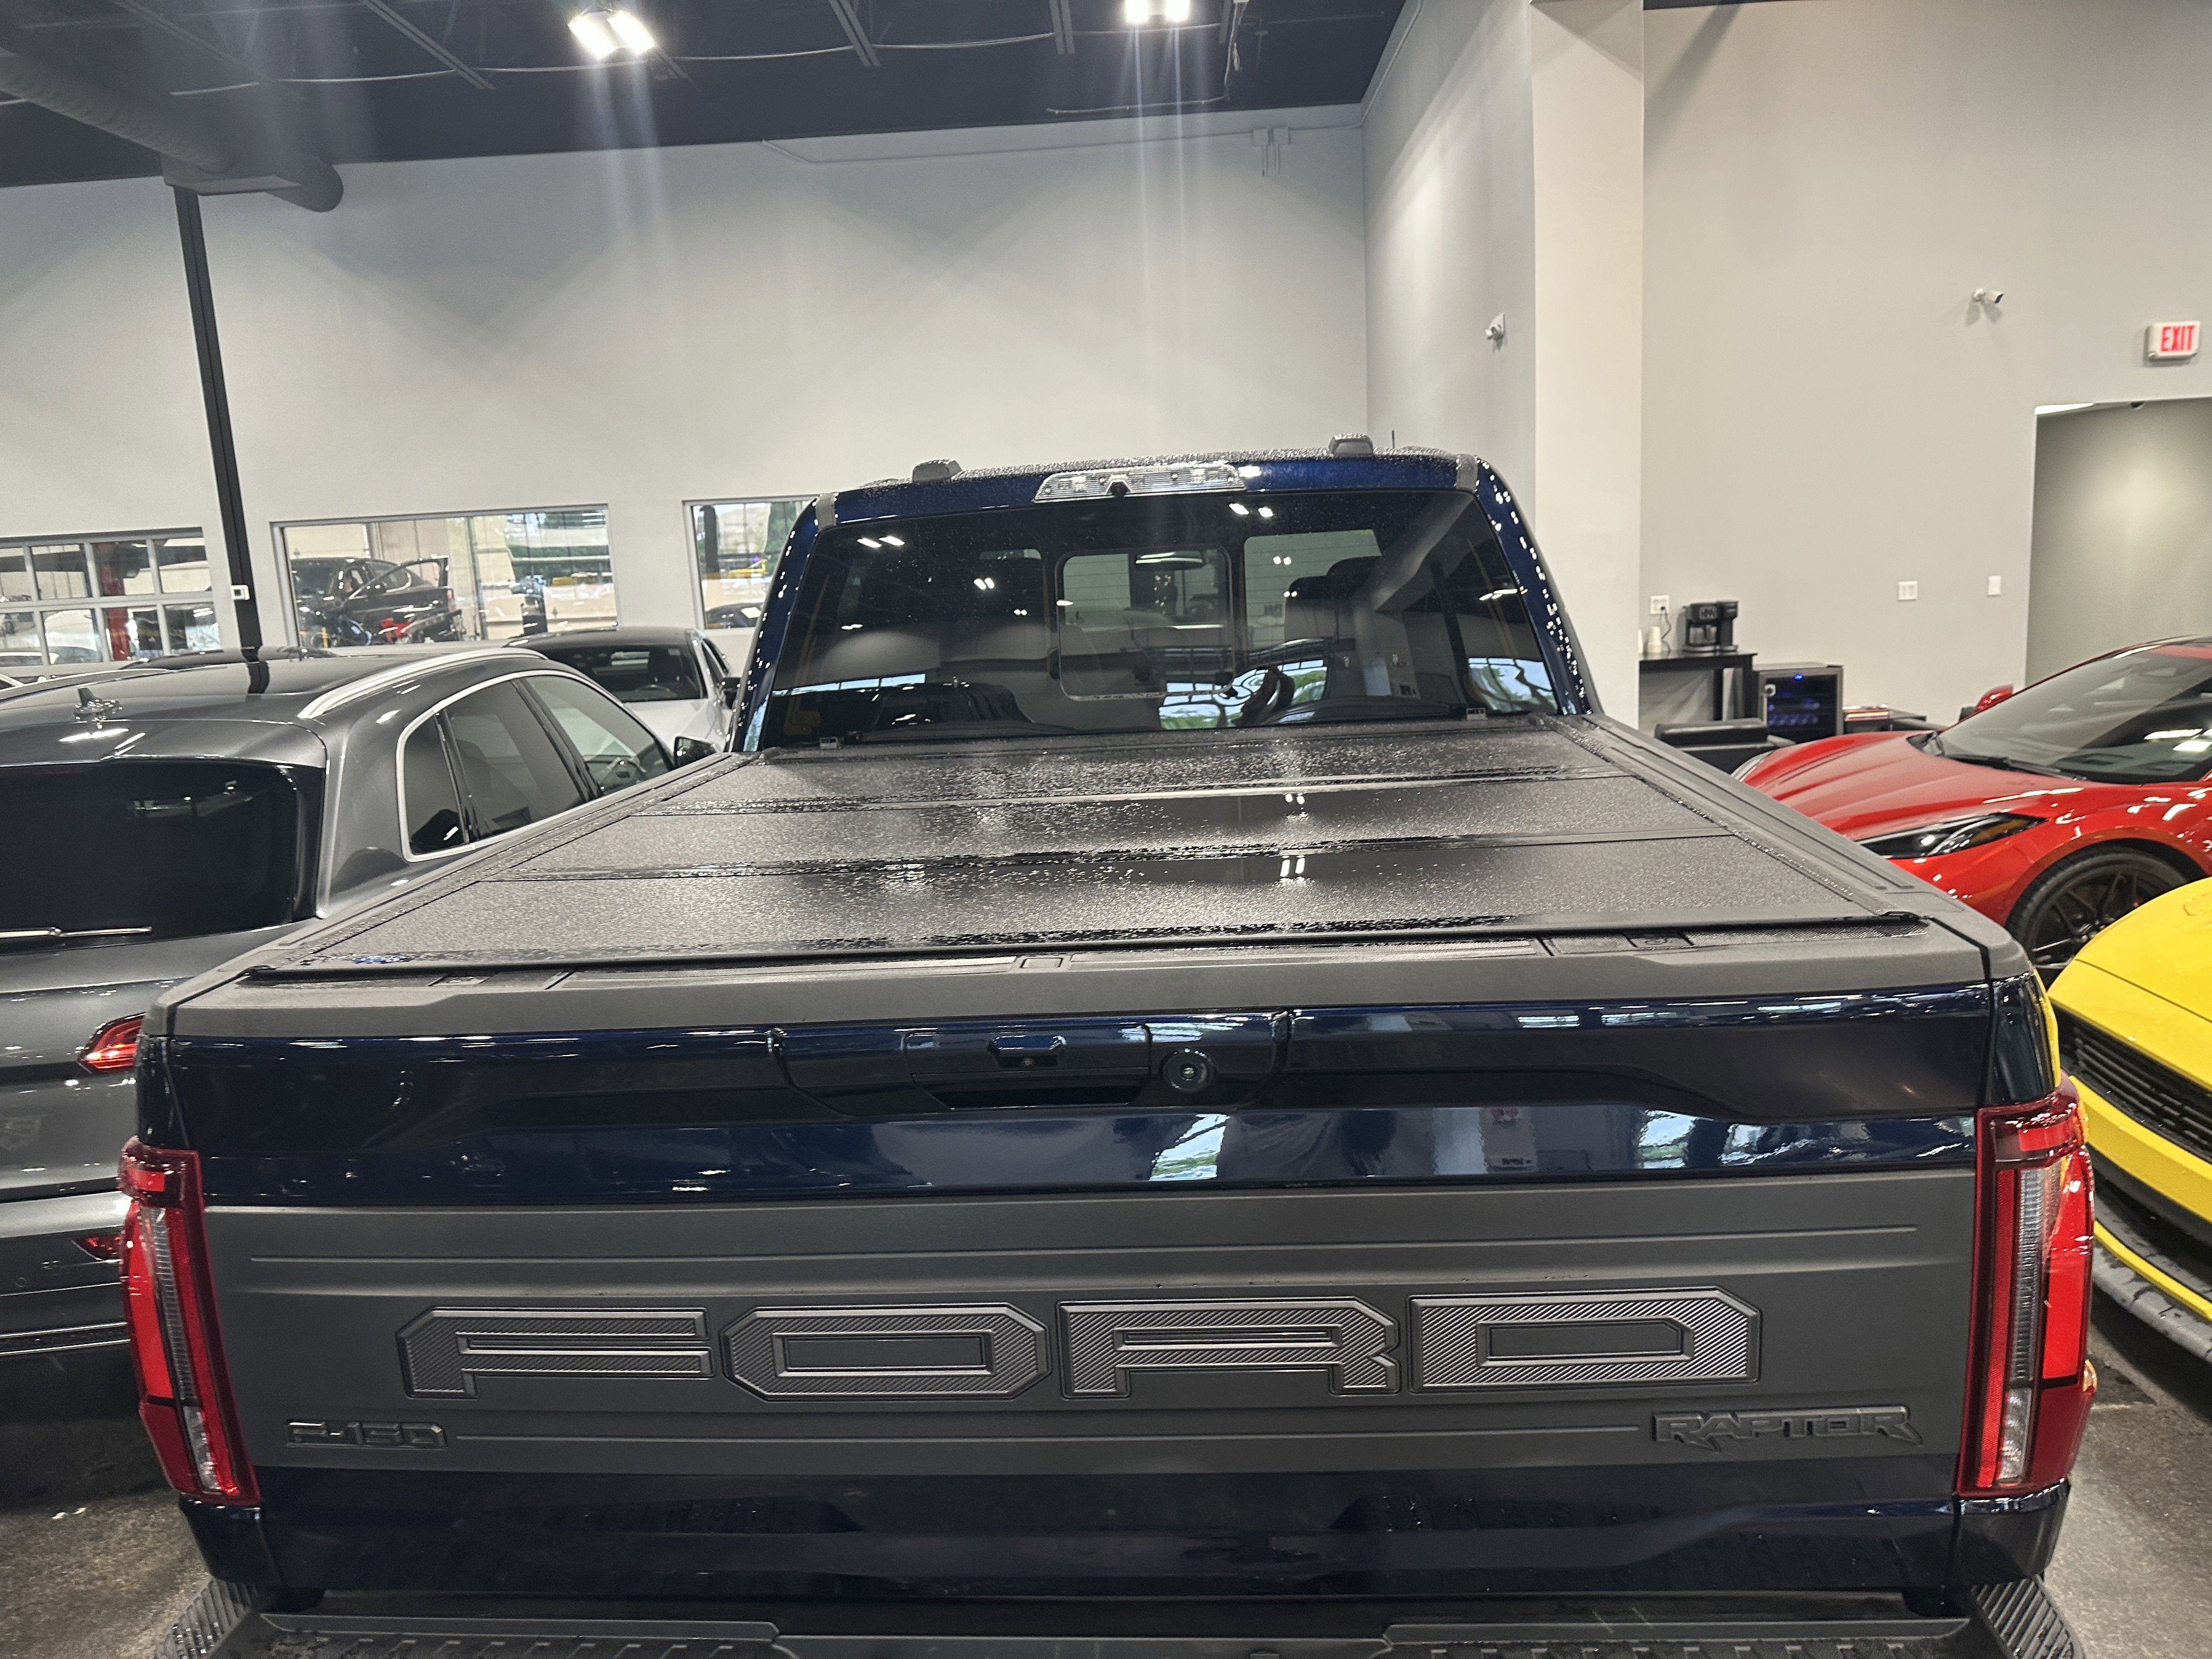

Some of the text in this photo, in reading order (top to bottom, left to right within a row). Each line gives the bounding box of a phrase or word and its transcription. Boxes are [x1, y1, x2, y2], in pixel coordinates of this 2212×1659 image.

[2160, 325, 2196, 352] EXIT
[396, 1286, 1762, 1402] FORD
[285, 1419, 448, 1450] F-150
[1651, 1405, 1923, 1453] RAPTOR
